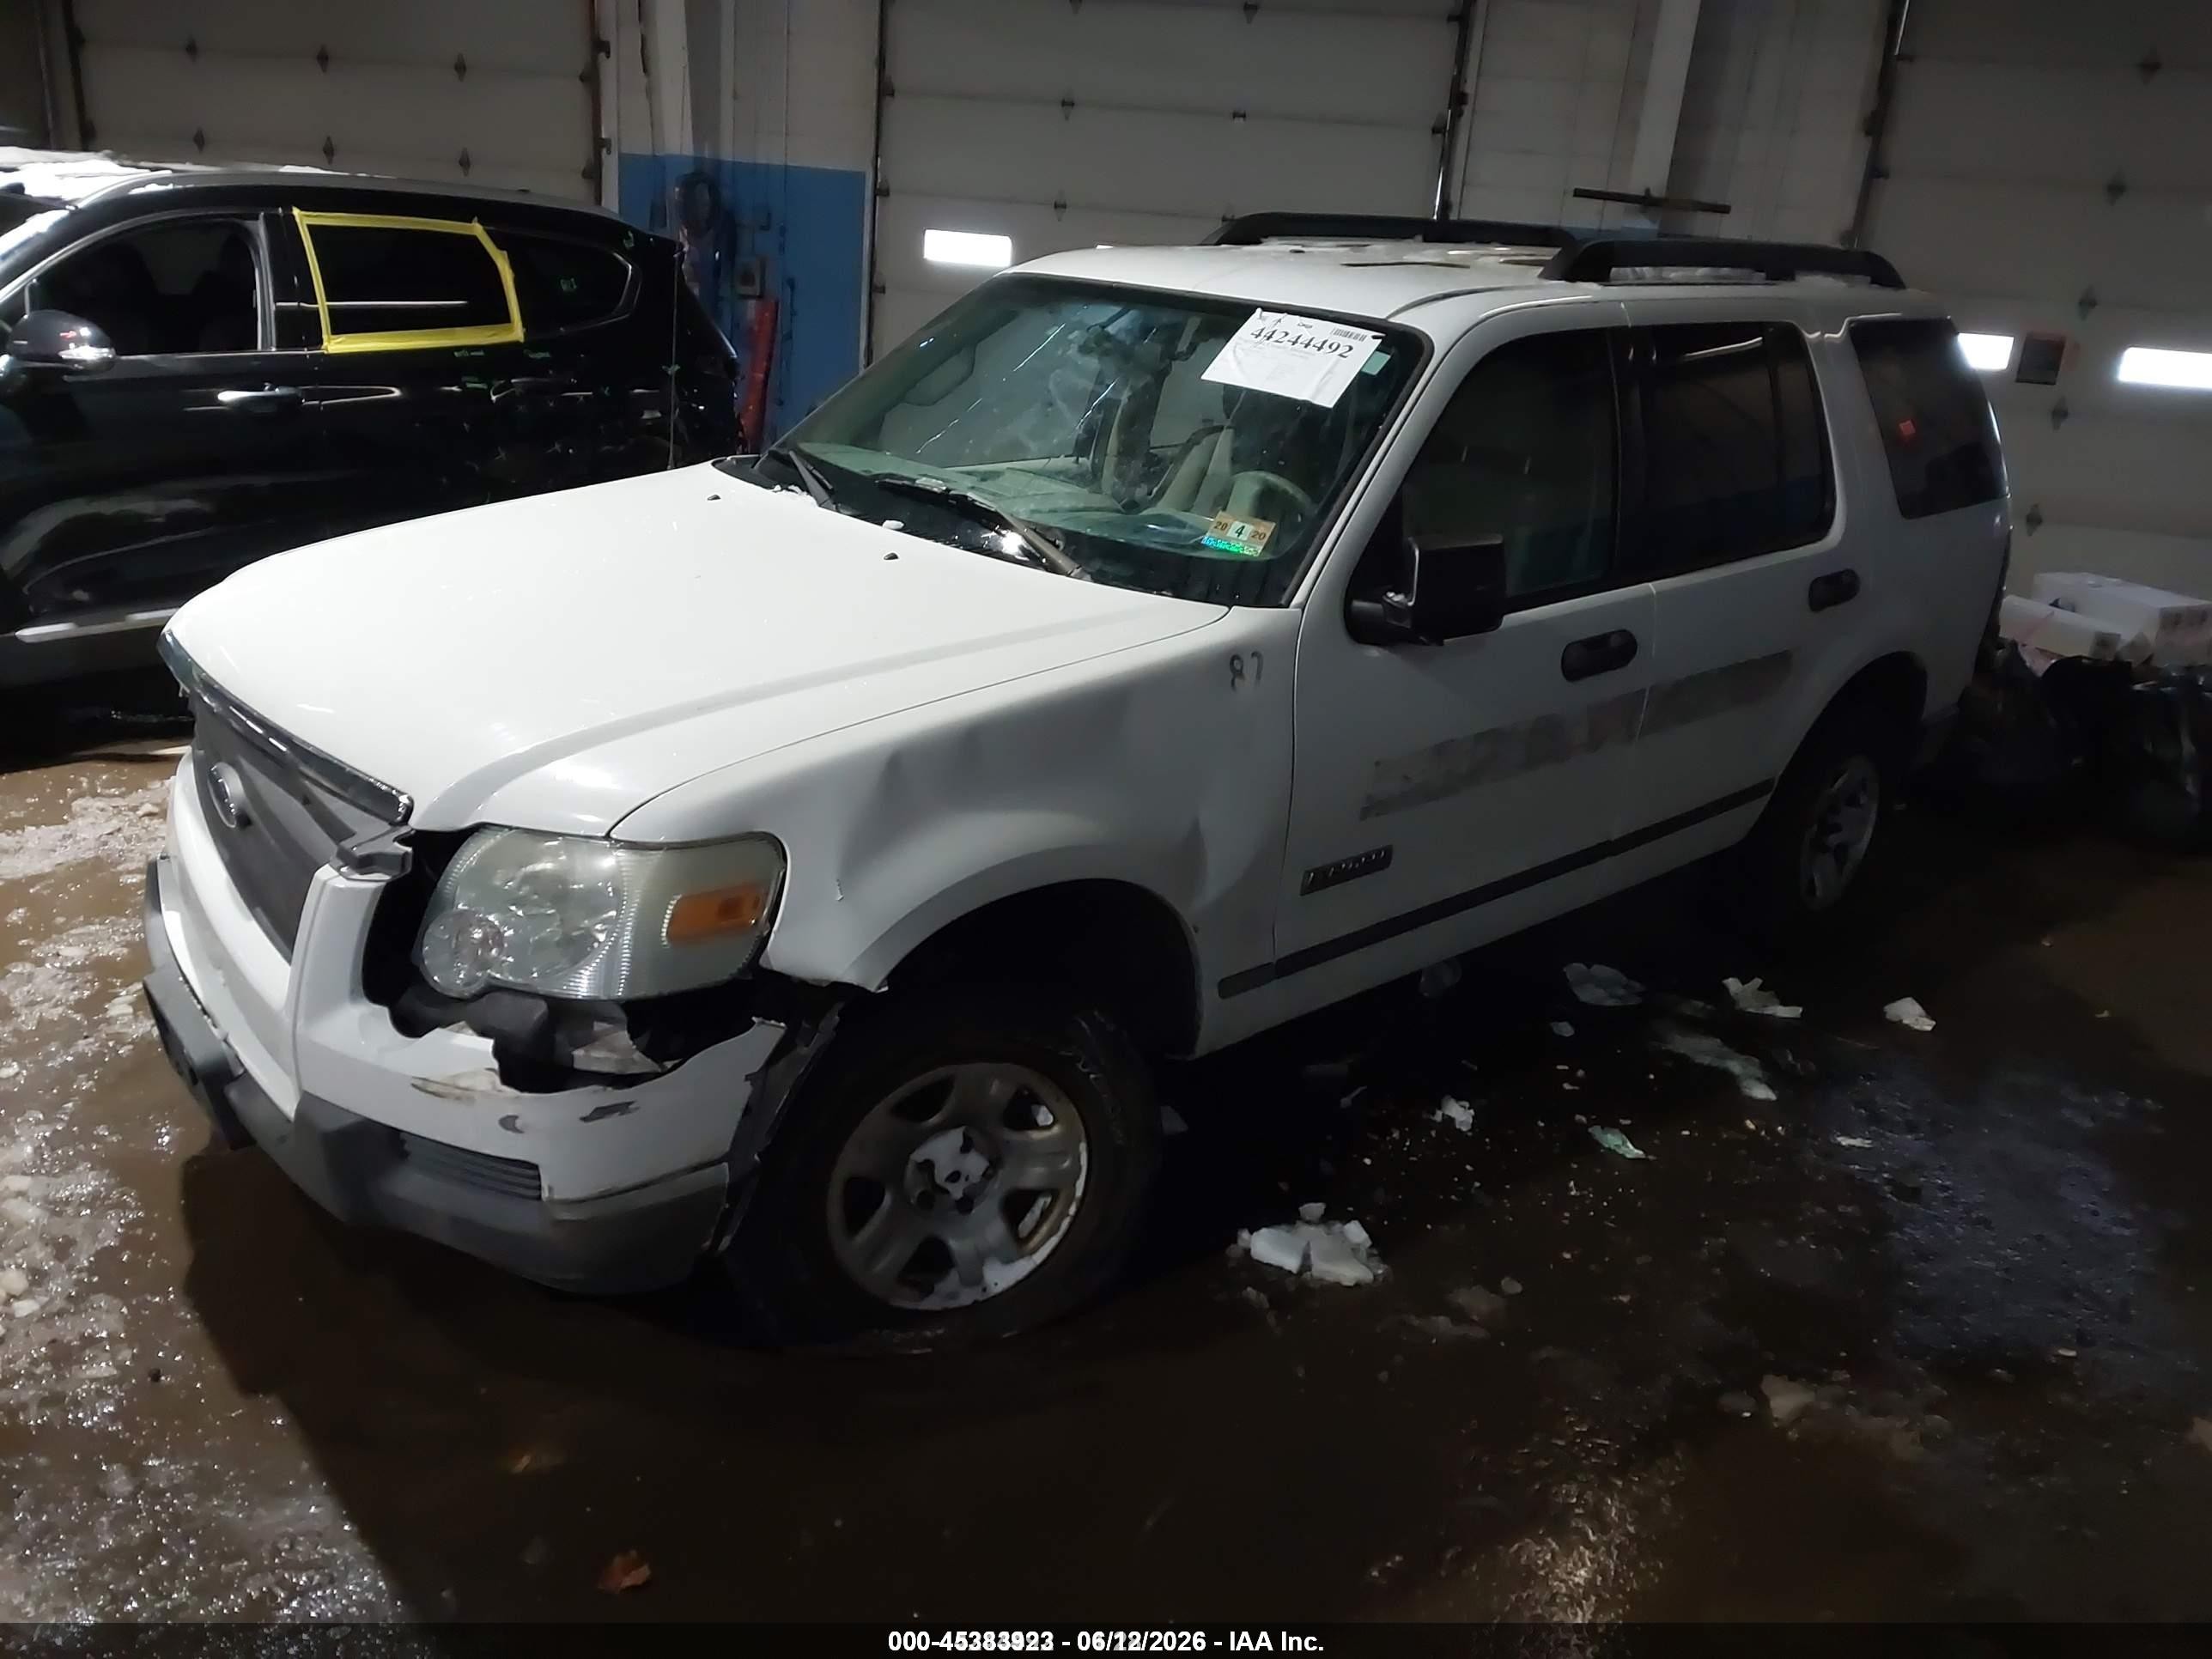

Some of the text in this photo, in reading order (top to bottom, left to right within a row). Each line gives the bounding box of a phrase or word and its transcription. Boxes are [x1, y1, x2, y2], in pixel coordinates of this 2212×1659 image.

[1250, 326, 1354, 359] 44244492
[1235, 525, 1246, 538] 4
[1251, 531, 1267, 541] 20
